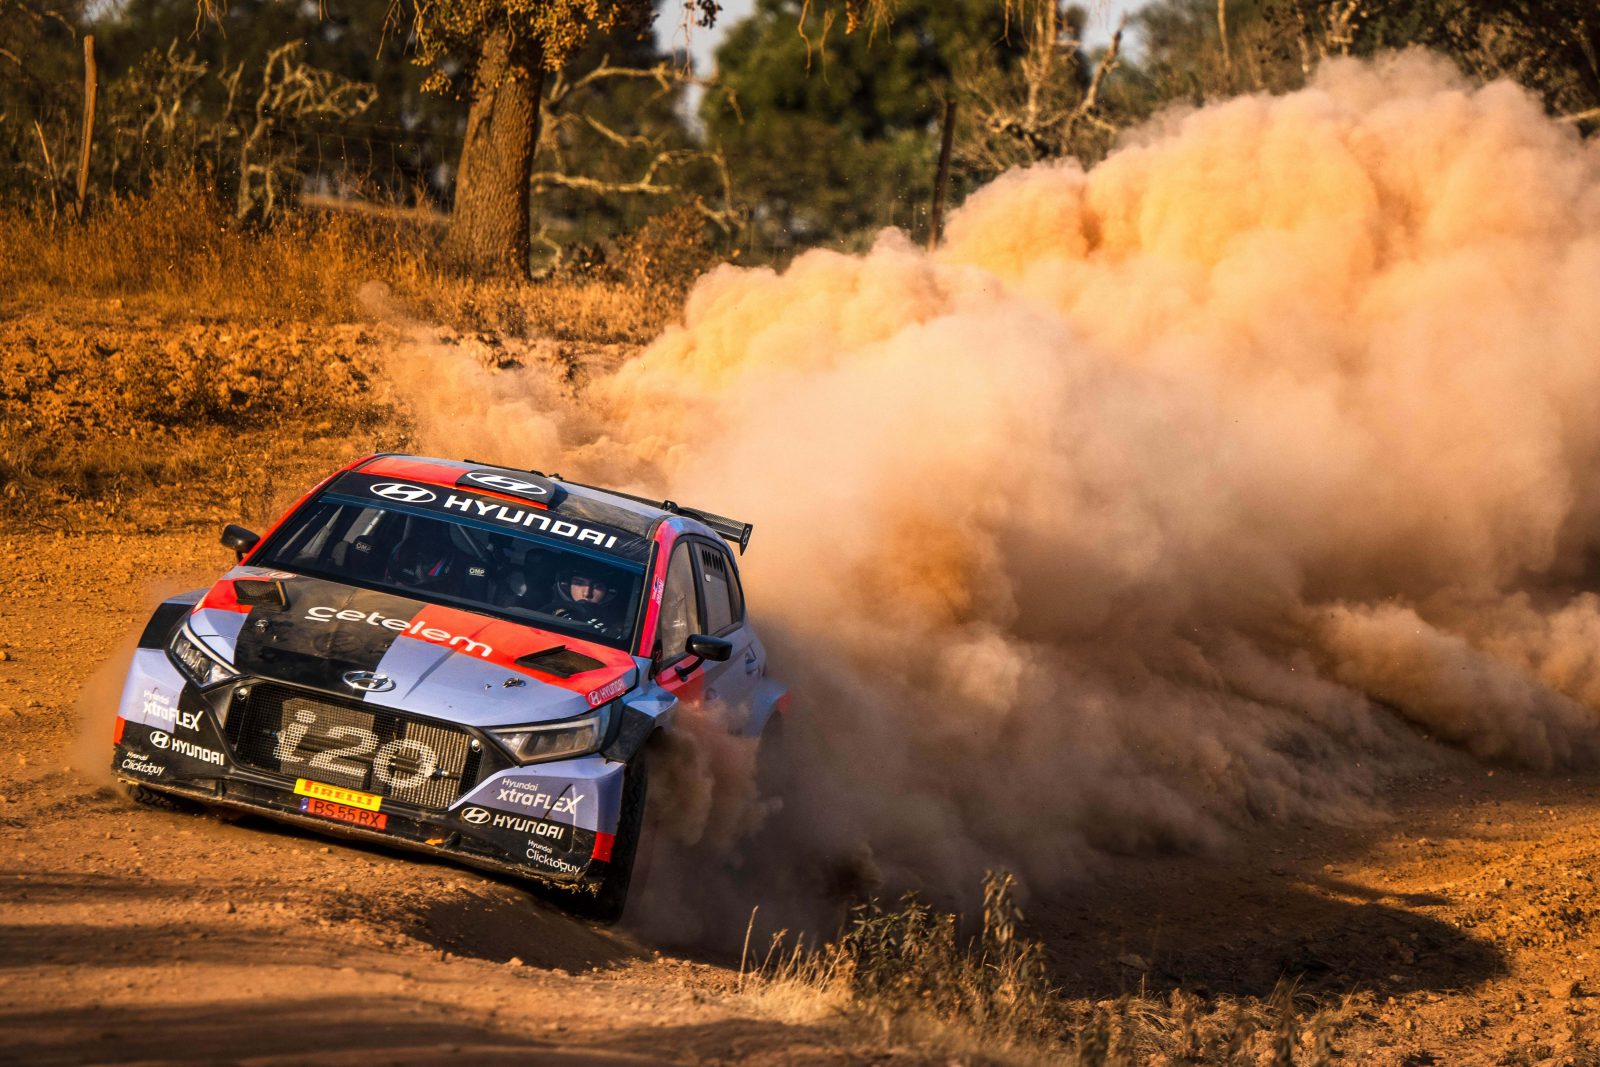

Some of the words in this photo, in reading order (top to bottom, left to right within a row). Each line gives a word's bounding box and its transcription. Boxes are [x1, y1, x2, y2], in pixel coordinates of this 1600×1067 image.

[444, 495, 617, 548] HYUNDAI
[469, 567, 485, 575] OMP
[304, 606, 493, 657] cetelem
[172, 738, 224, 766] HYUNDAI
[273, 710, 437, 788] i20
[304, 781, 375, 806] PIRELLI
[502, 778, 539, 791] Hyundai
[497, 788, 584, 815] xtraFLEX
[493, 814, 564, 839] HYUNDAI
[528, 839, 552, 853] Hyundai
